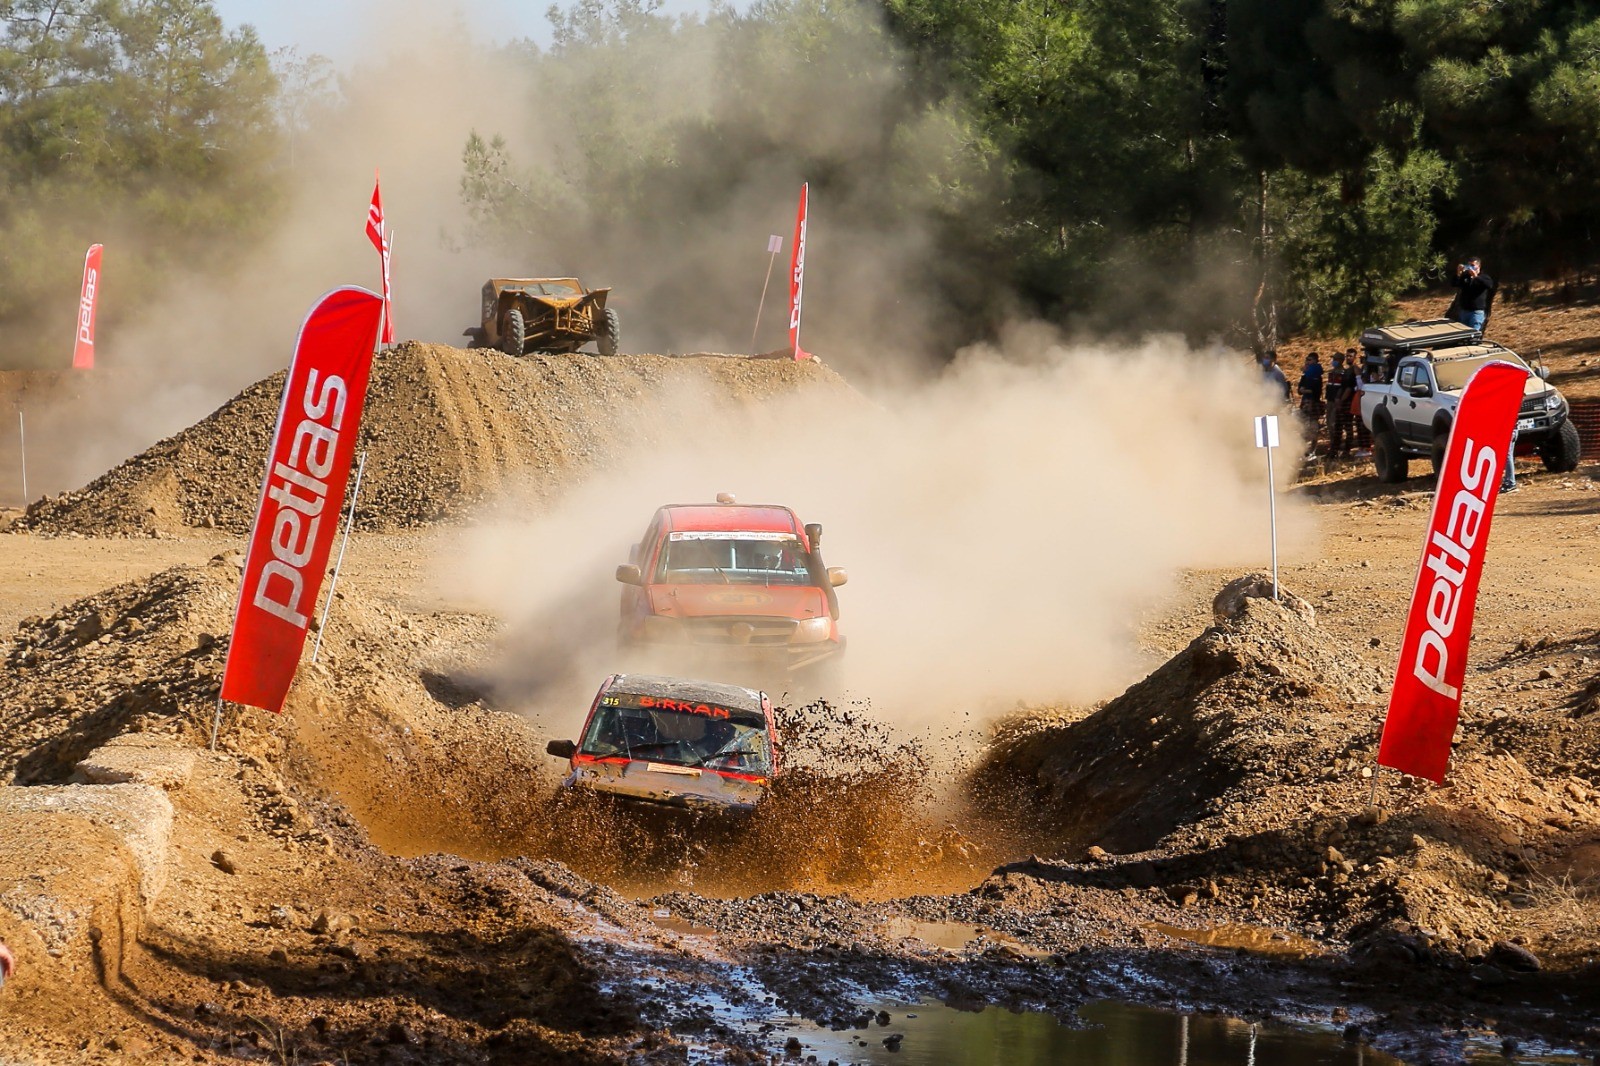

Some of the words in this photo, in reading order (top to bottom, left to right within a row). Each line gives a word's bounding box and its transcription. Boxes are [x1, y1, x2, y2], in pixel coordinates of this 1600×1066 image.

[80, 267, 97, 346] petlas
[253, 368, 348, 630] petlas
[1413, 438, 1497, 701] petlas
[602, 697, 620, 706] 315
